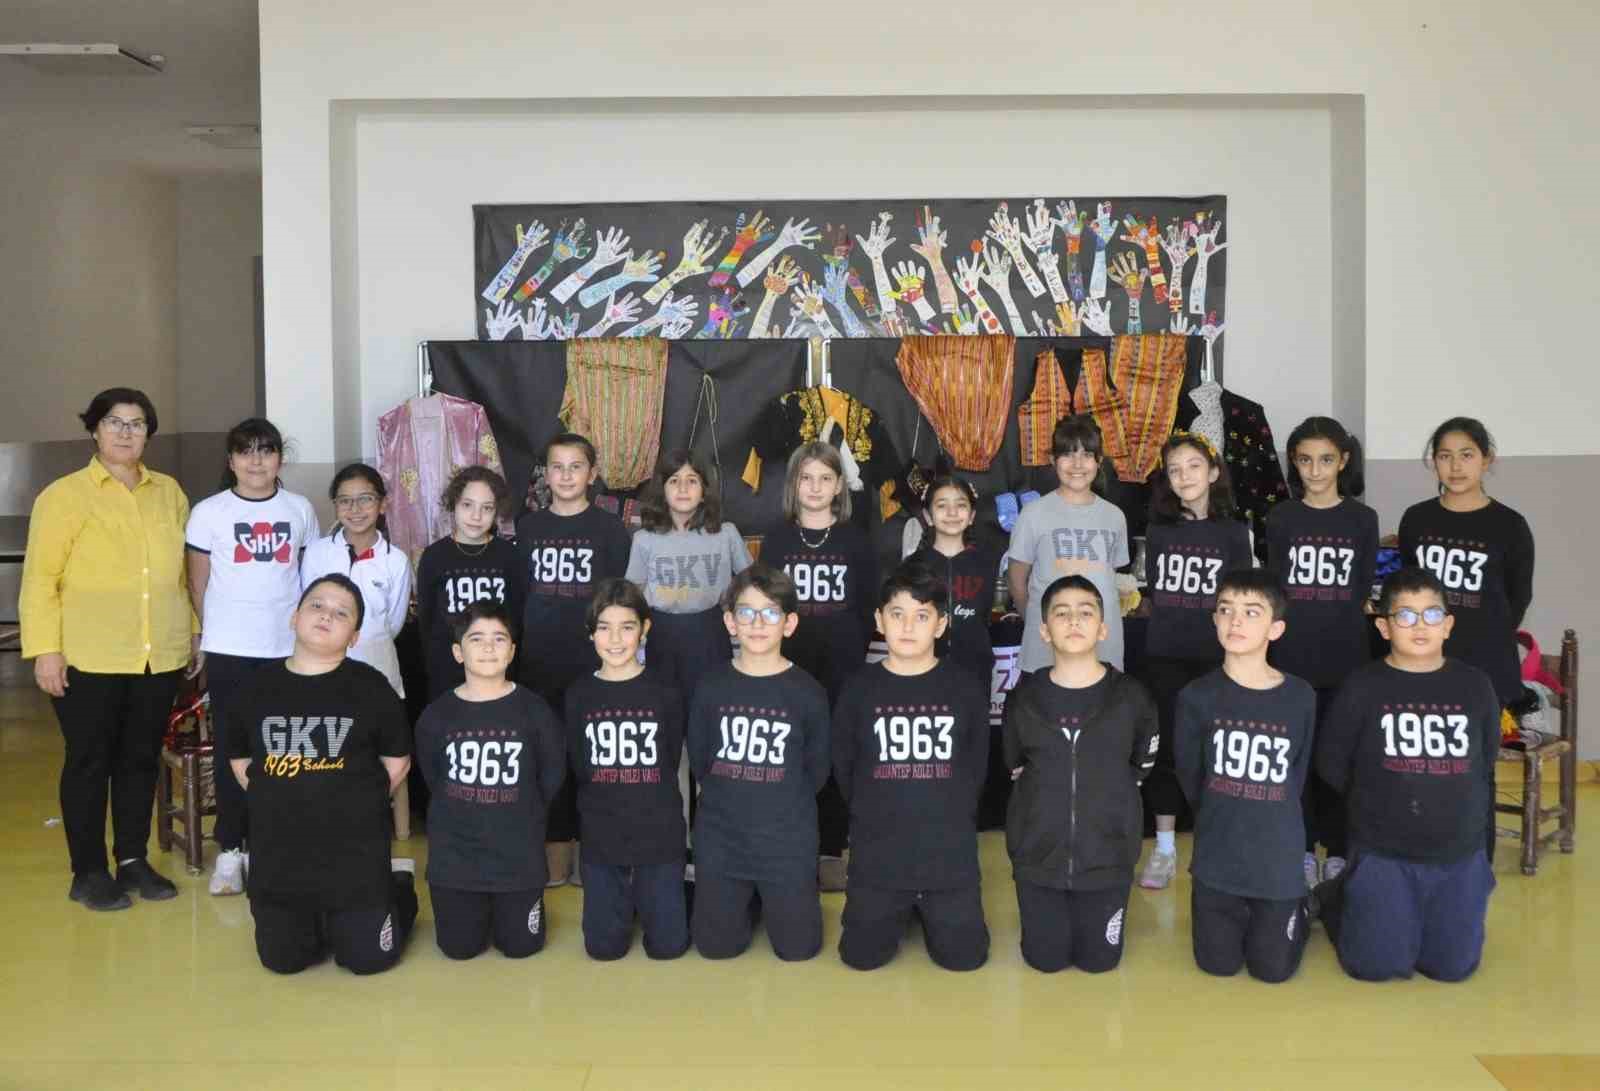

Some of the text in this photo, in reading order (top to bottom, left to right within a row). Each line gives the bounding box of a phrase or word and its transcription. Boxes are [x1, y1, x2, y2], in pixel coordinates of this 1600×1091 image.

[531, 547, 594, 583] 1963
[655, 553, 721, 588] GKV
[1155, 553, 1223, 595] 1963
[1288, 545, 1355, 586] 1963
[1416, 544, 1489, 592] 1963
[445, 576, 505, 613] 1963
[262, 716, 353, 757] GKV
[584, 720, 659, 767] 1963
[716, 715, 792, 765] 1963
[873, 715, 955, 762] 1963
[1212, 728, 1291, 784] 1963
[1380, 712, 1470, 758] 1963
[264, 752, 302, 777] 1963
[445, 740, 523, 786] 1963
